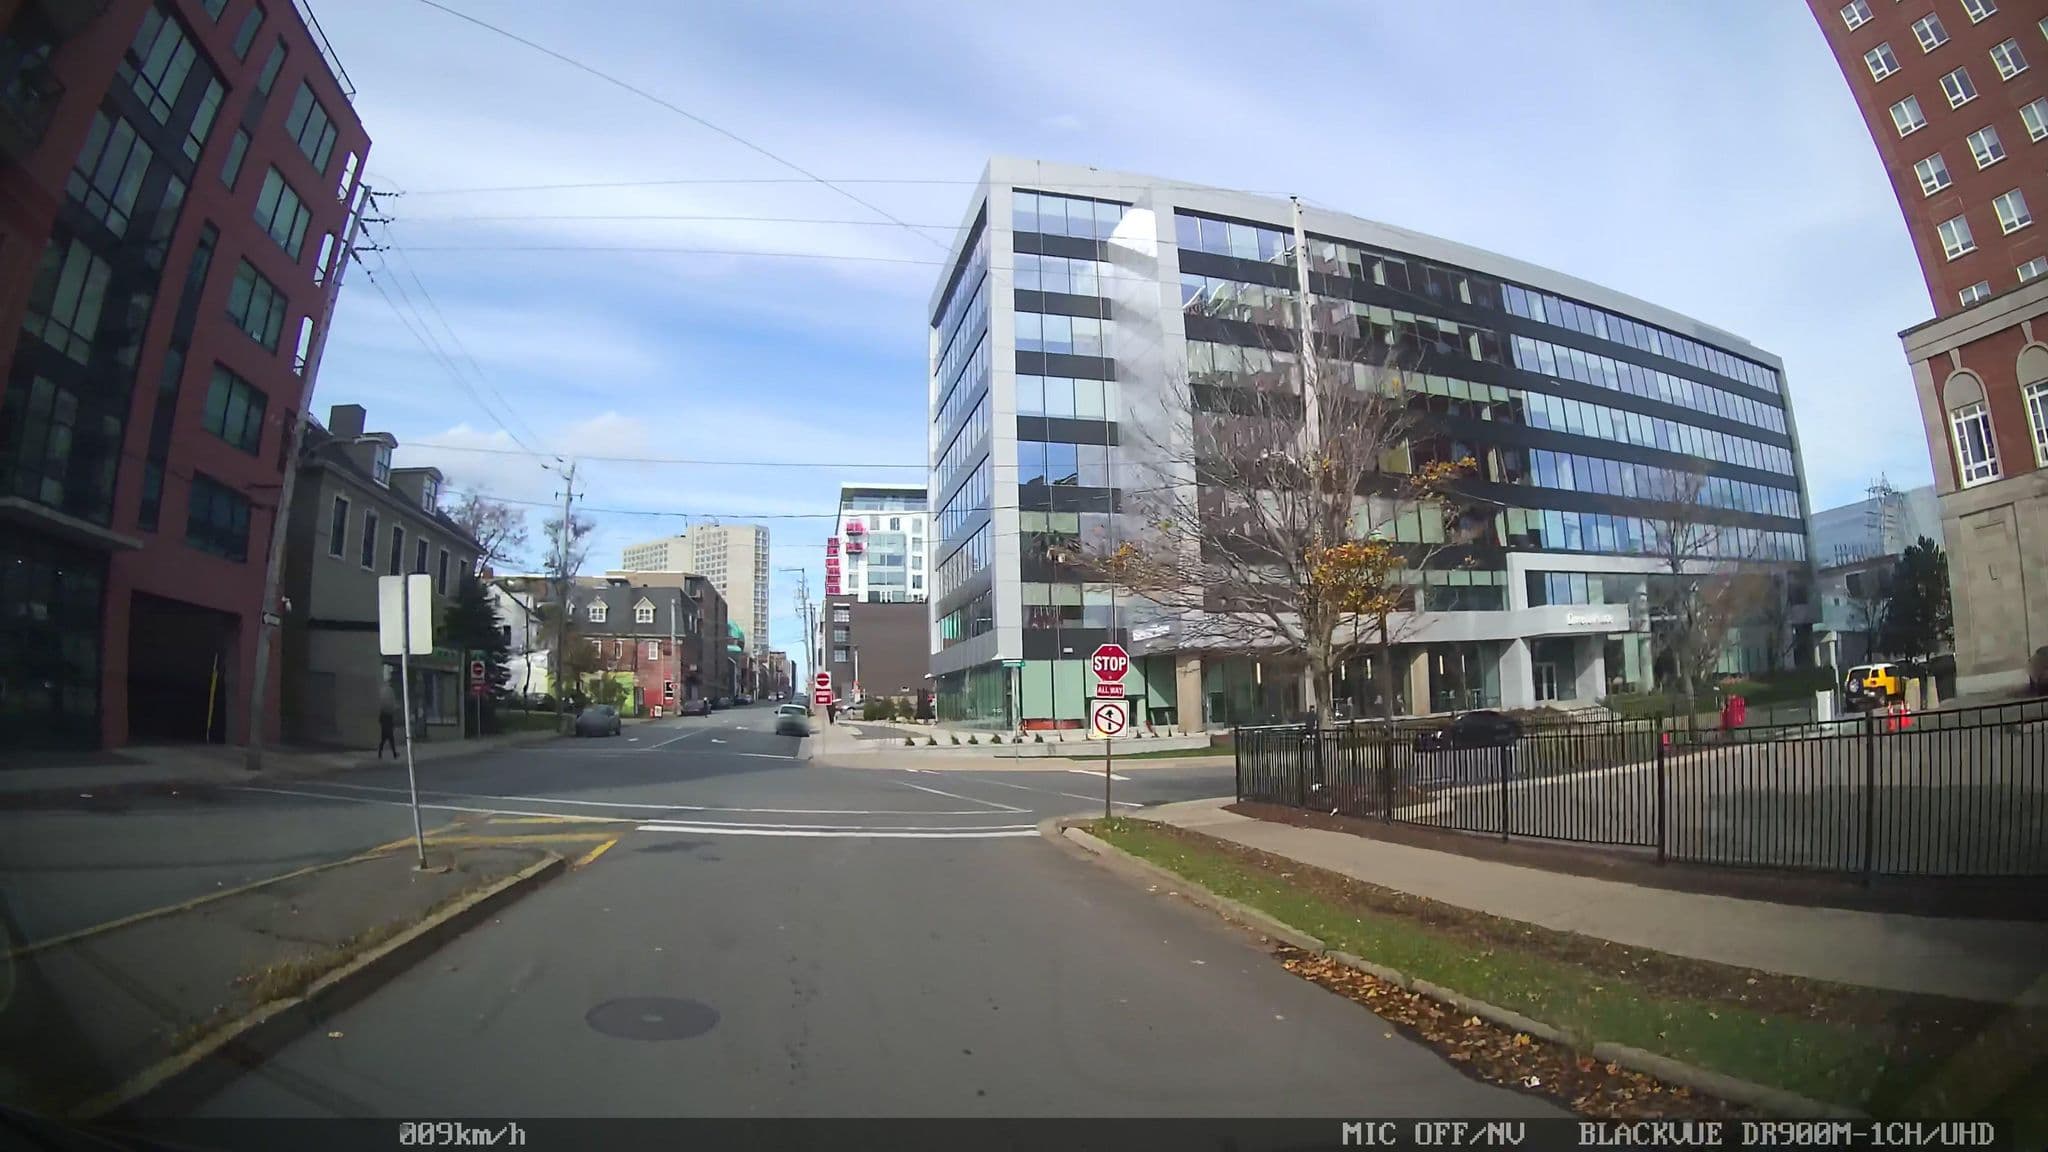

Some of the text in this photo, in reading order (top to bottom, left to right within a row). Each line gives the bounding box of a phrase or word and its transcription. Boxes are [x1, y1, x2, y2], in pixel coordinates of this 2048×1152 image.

[1094, 656, 1127, 671] STOP
[1097, 686, 1123, 694] ALL WAY
